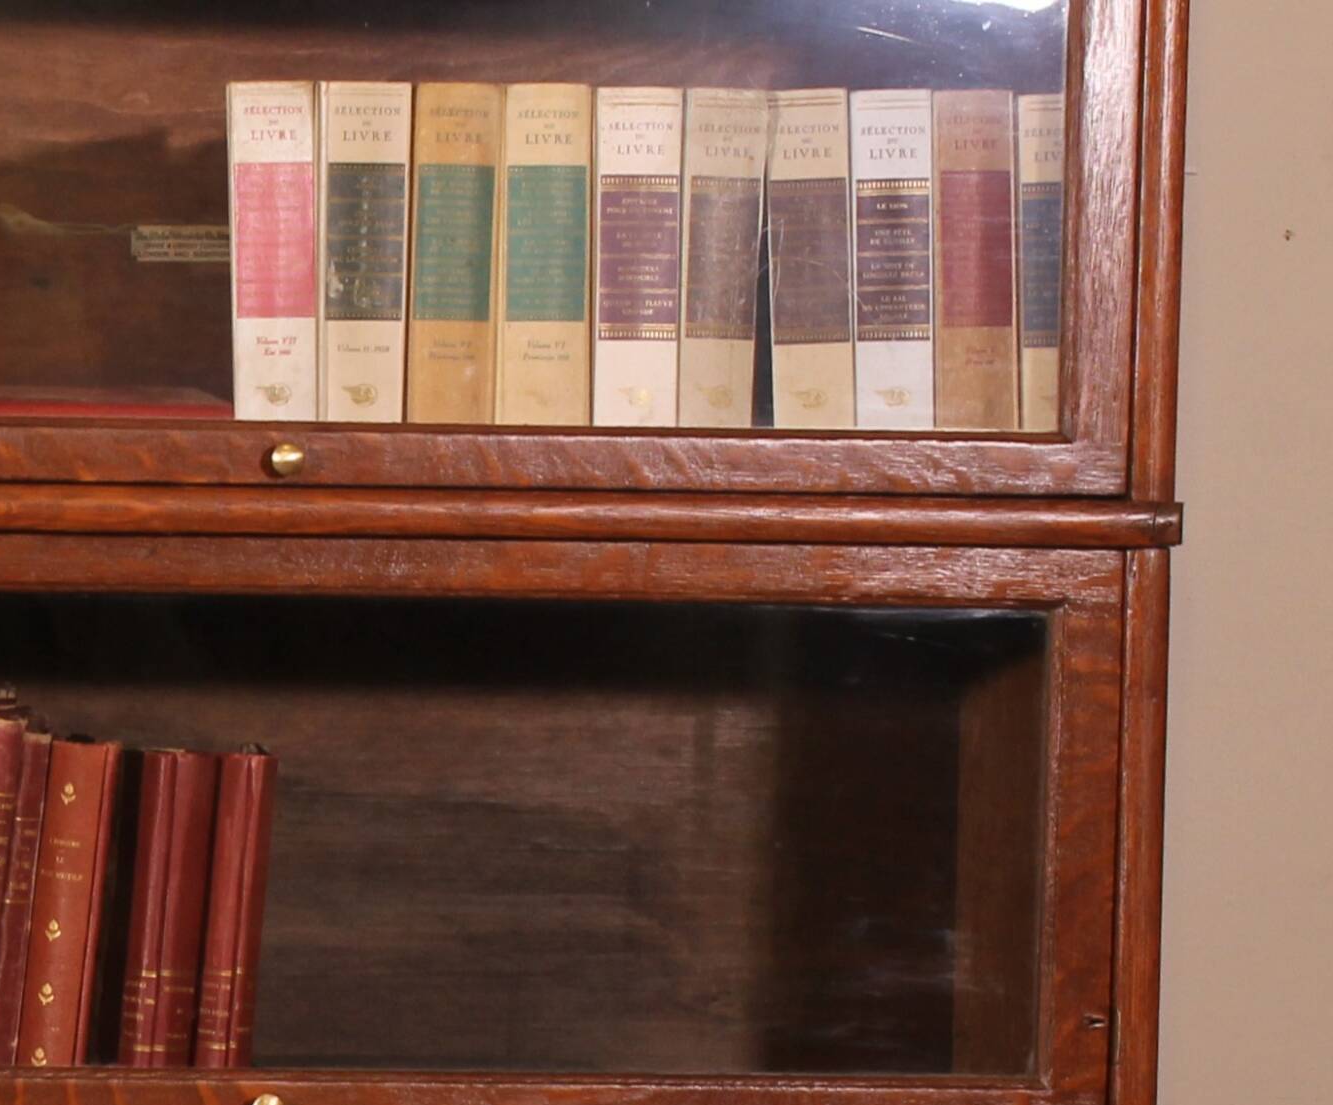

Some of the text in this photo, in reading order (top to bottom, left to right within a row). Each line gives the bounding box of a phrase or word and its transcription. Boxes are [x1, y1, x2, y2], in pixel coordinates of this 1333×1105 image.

[251, 129, 298, 141] LIVRE
[342, 130, 393, 142] LIVRE
[525, 133, 573, 145] LIVRE
[616, 144, 666, 156] LIVRE
[705, 146, 750, 159] LIVRE
[783, 147, 833, 160] LIVRE
[869, 147, 918, 160] LIVRE
